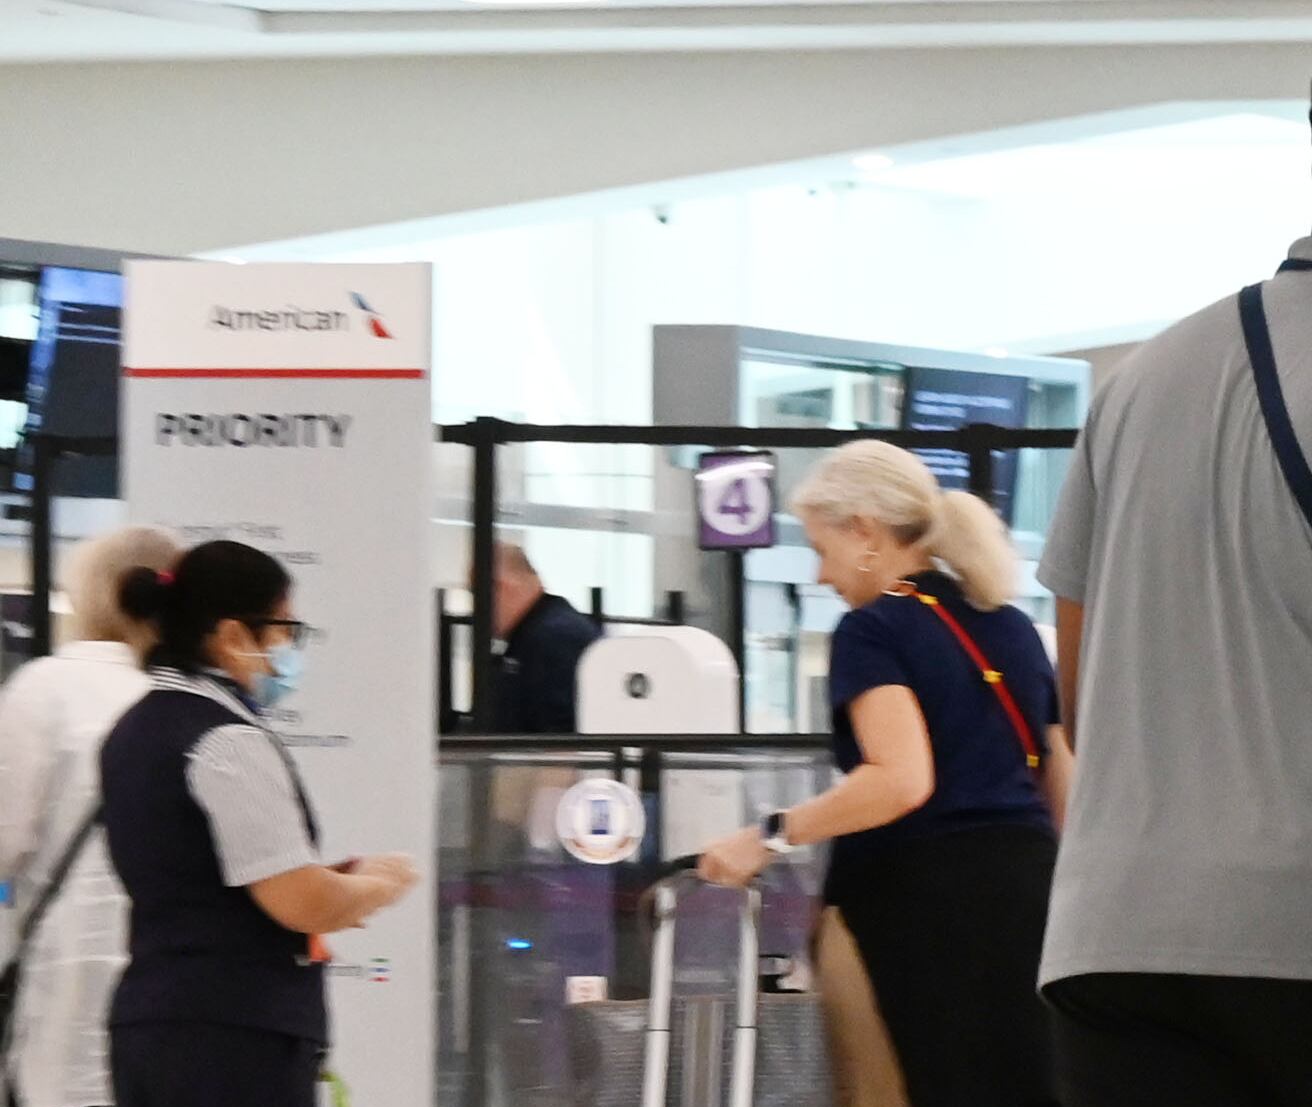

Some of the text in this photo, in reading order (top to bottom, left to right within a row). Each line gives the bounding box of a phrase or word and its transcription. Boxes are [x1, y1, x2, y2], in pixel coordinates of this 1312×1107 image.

[210, 303, 349, 331] American
[155, 412, 354, 448] PRIORITY
[716, 478, 755, 526] 4
